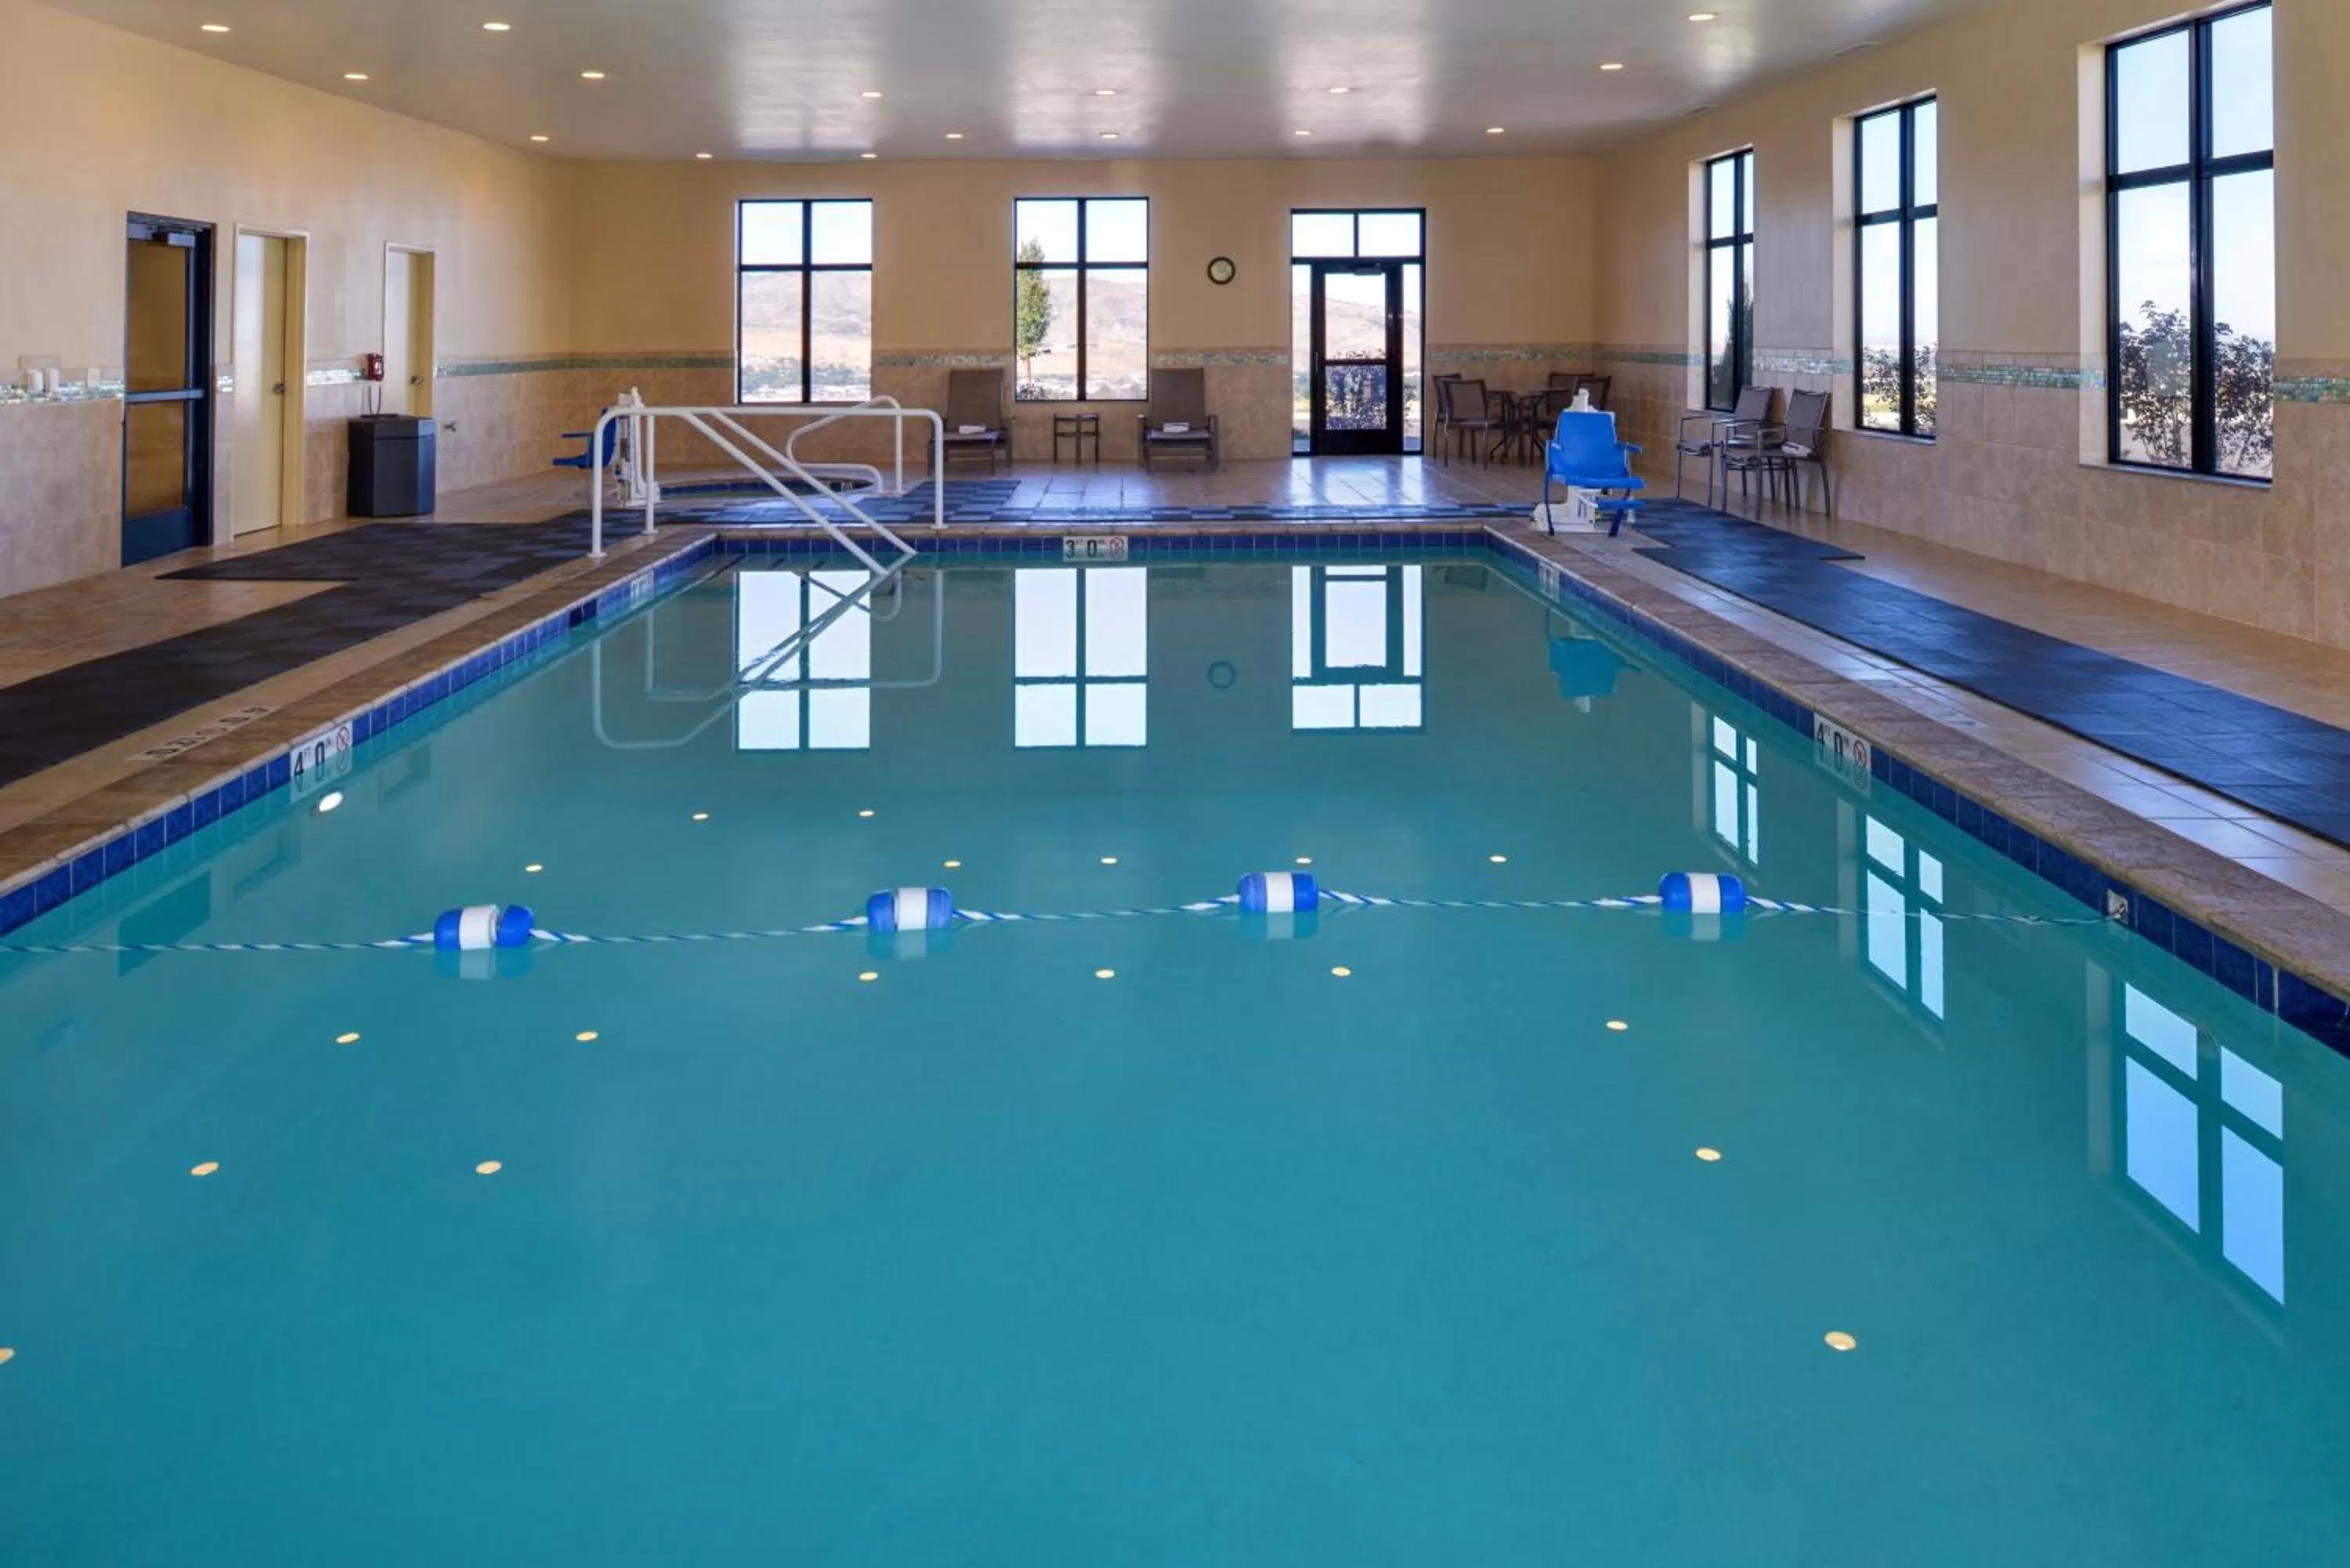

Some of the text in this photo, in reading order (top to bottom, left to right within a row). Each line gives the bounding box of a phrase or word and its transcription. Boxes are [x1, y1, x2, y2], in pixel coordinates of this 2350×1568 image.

[1066, 539, 1097, 558] 3 0
[1817, 721, 1825, 747] 4
[294, 751, 305, 776] 4
